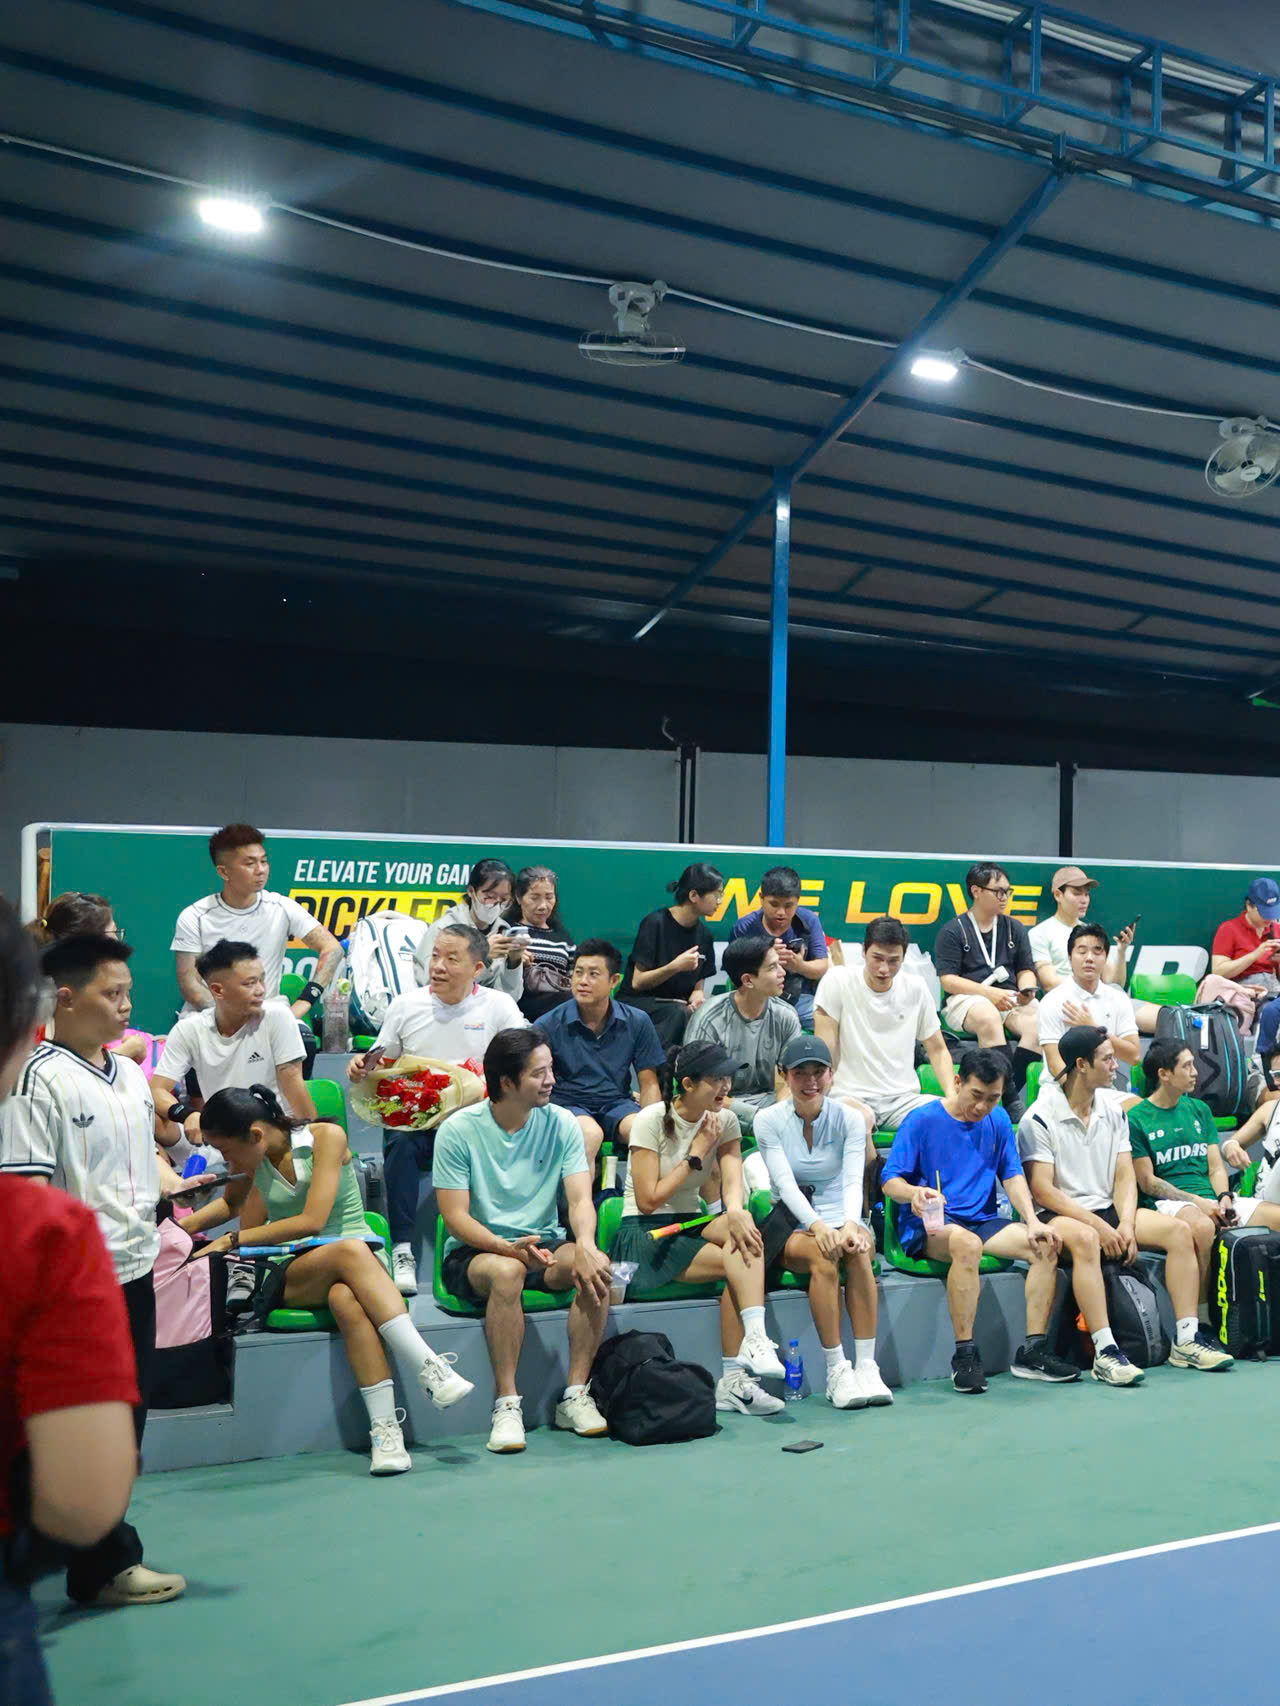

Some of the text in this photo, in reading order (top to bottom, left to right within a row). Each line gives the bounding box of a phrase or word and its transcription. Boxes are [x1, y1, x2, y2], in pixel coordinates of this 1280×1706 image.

[294, 859, 475, 886] ELEVATE YOUR GAM
[1156, 1142, 1209, 1165] MIDAS
